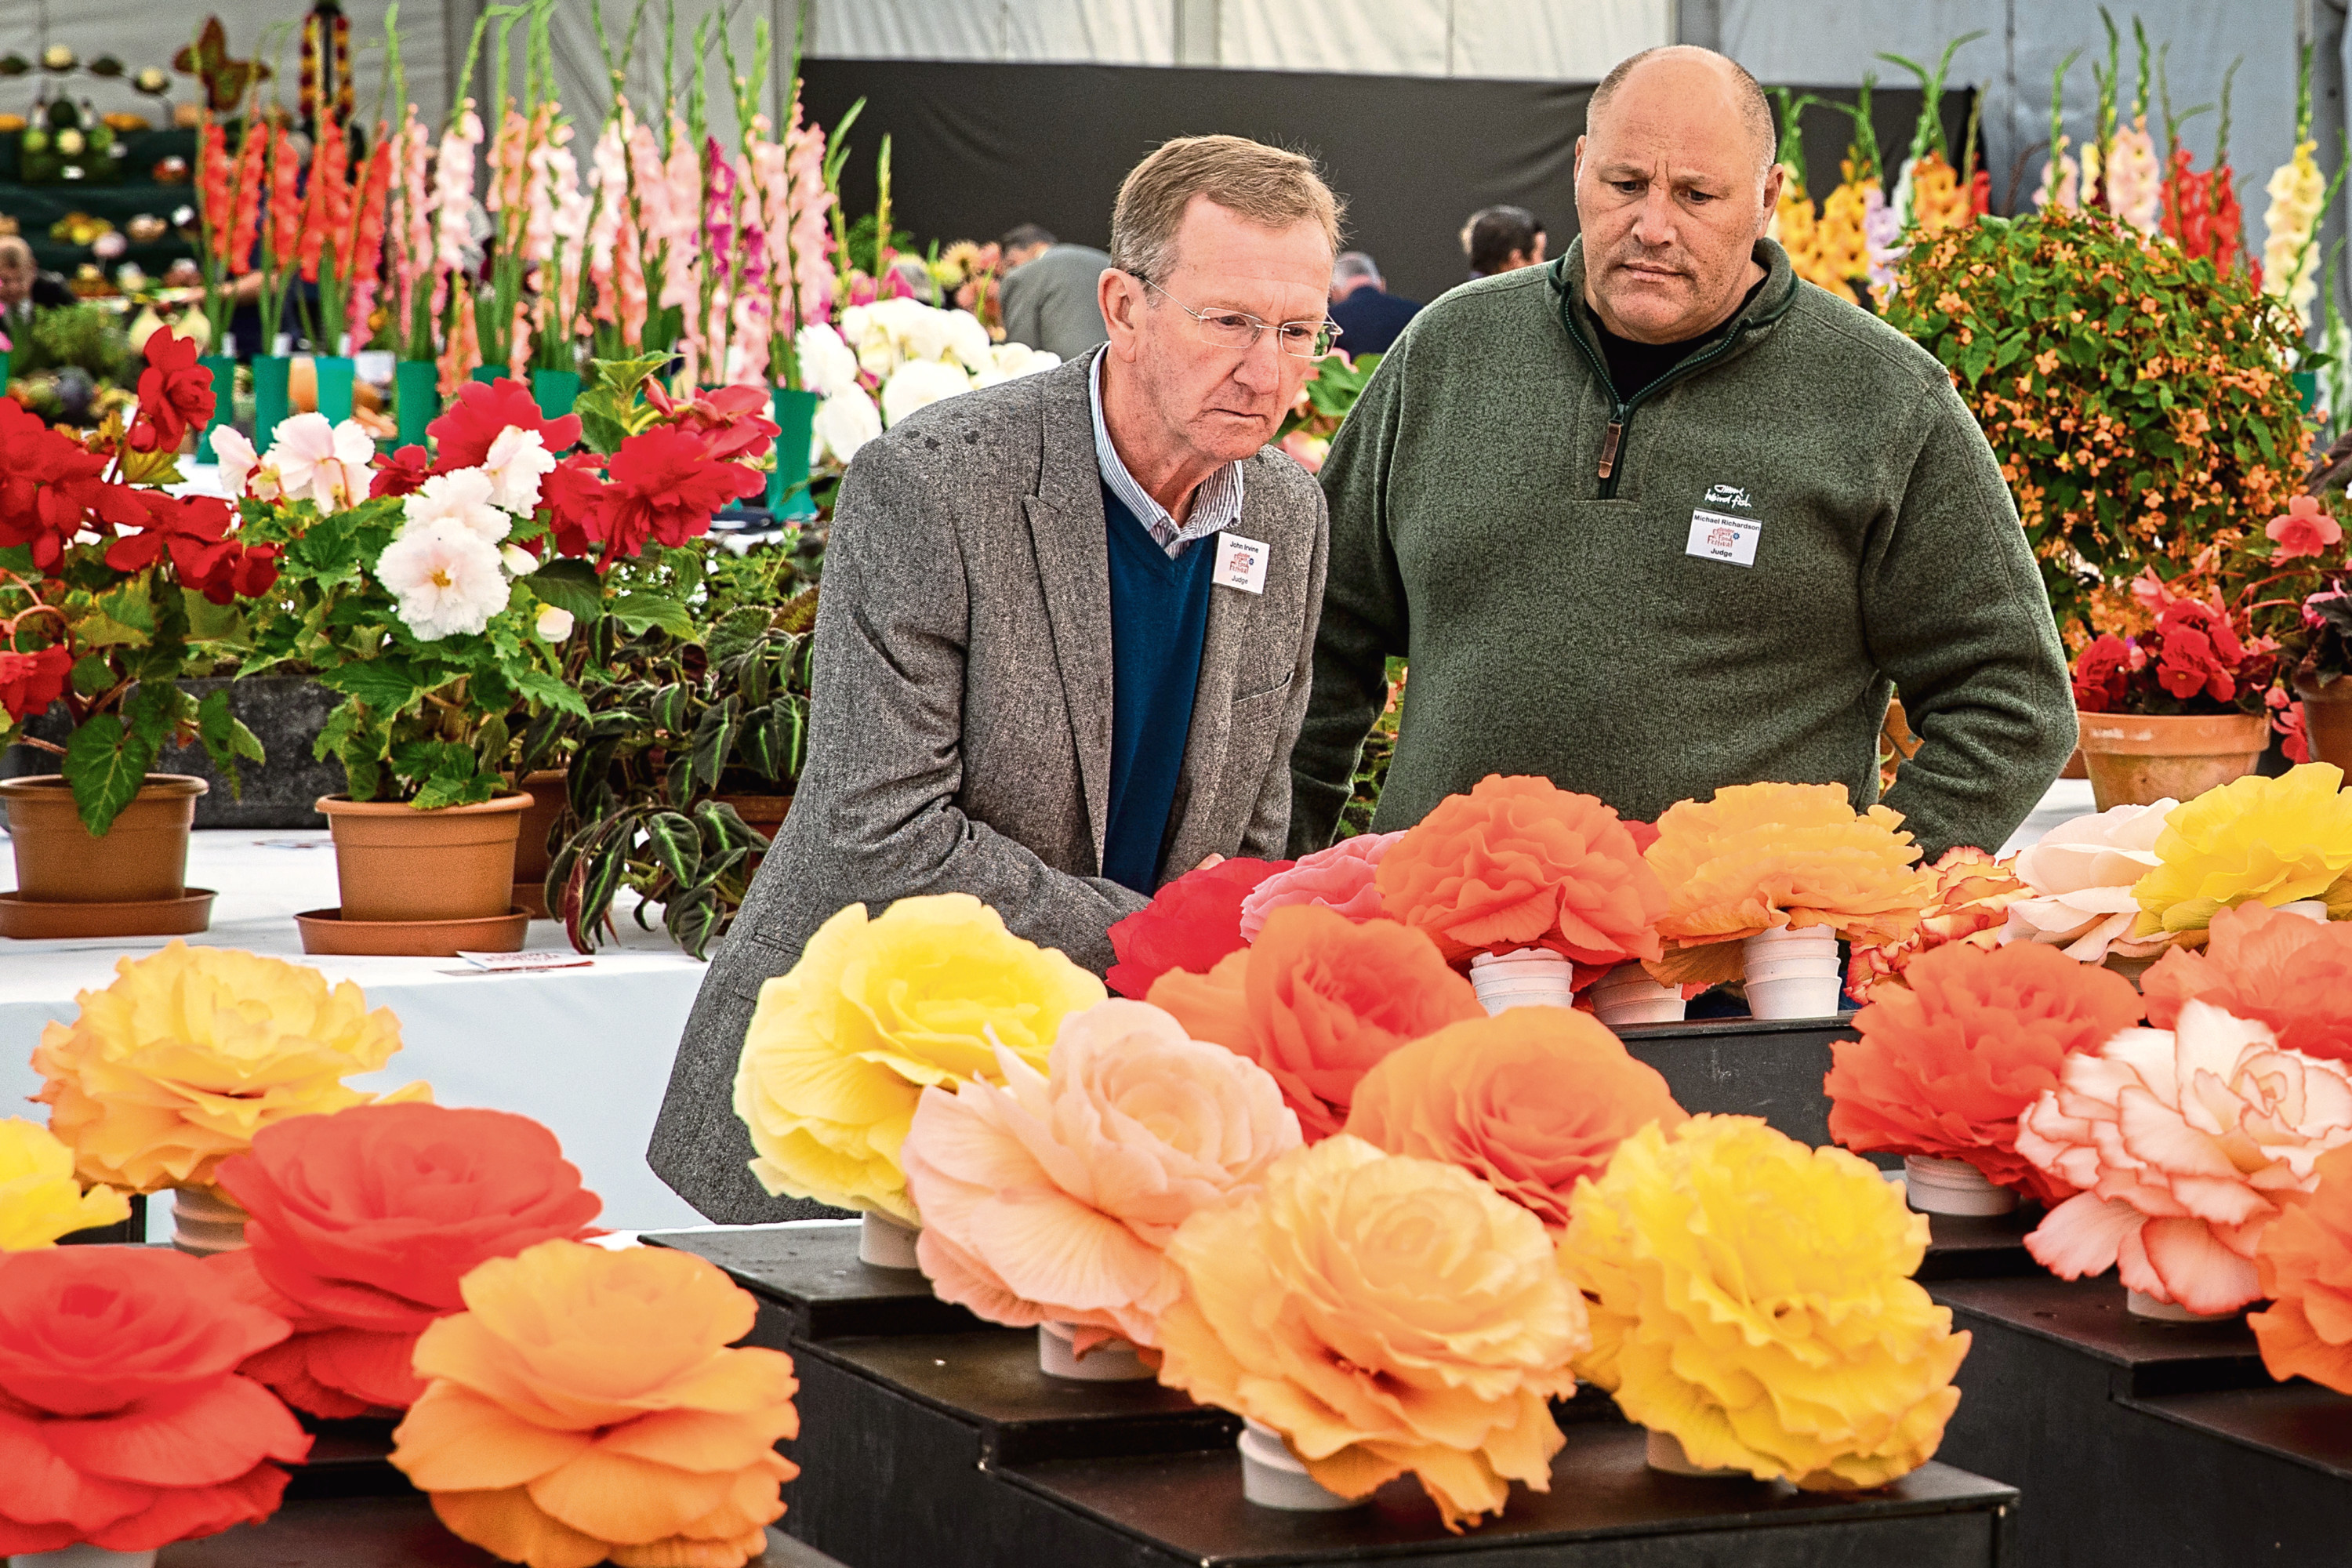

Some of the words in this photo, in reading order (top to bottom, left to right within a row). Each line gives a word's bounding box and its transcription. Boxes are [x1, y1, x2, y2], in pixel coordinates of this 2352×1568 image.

[1694, 514, 1720, 524] Michael
[1722, 519, 1760, 531] Richardson
[1244, 544, 1258, 553] Irvine
[1232, 575, 1248, 585] Judge
